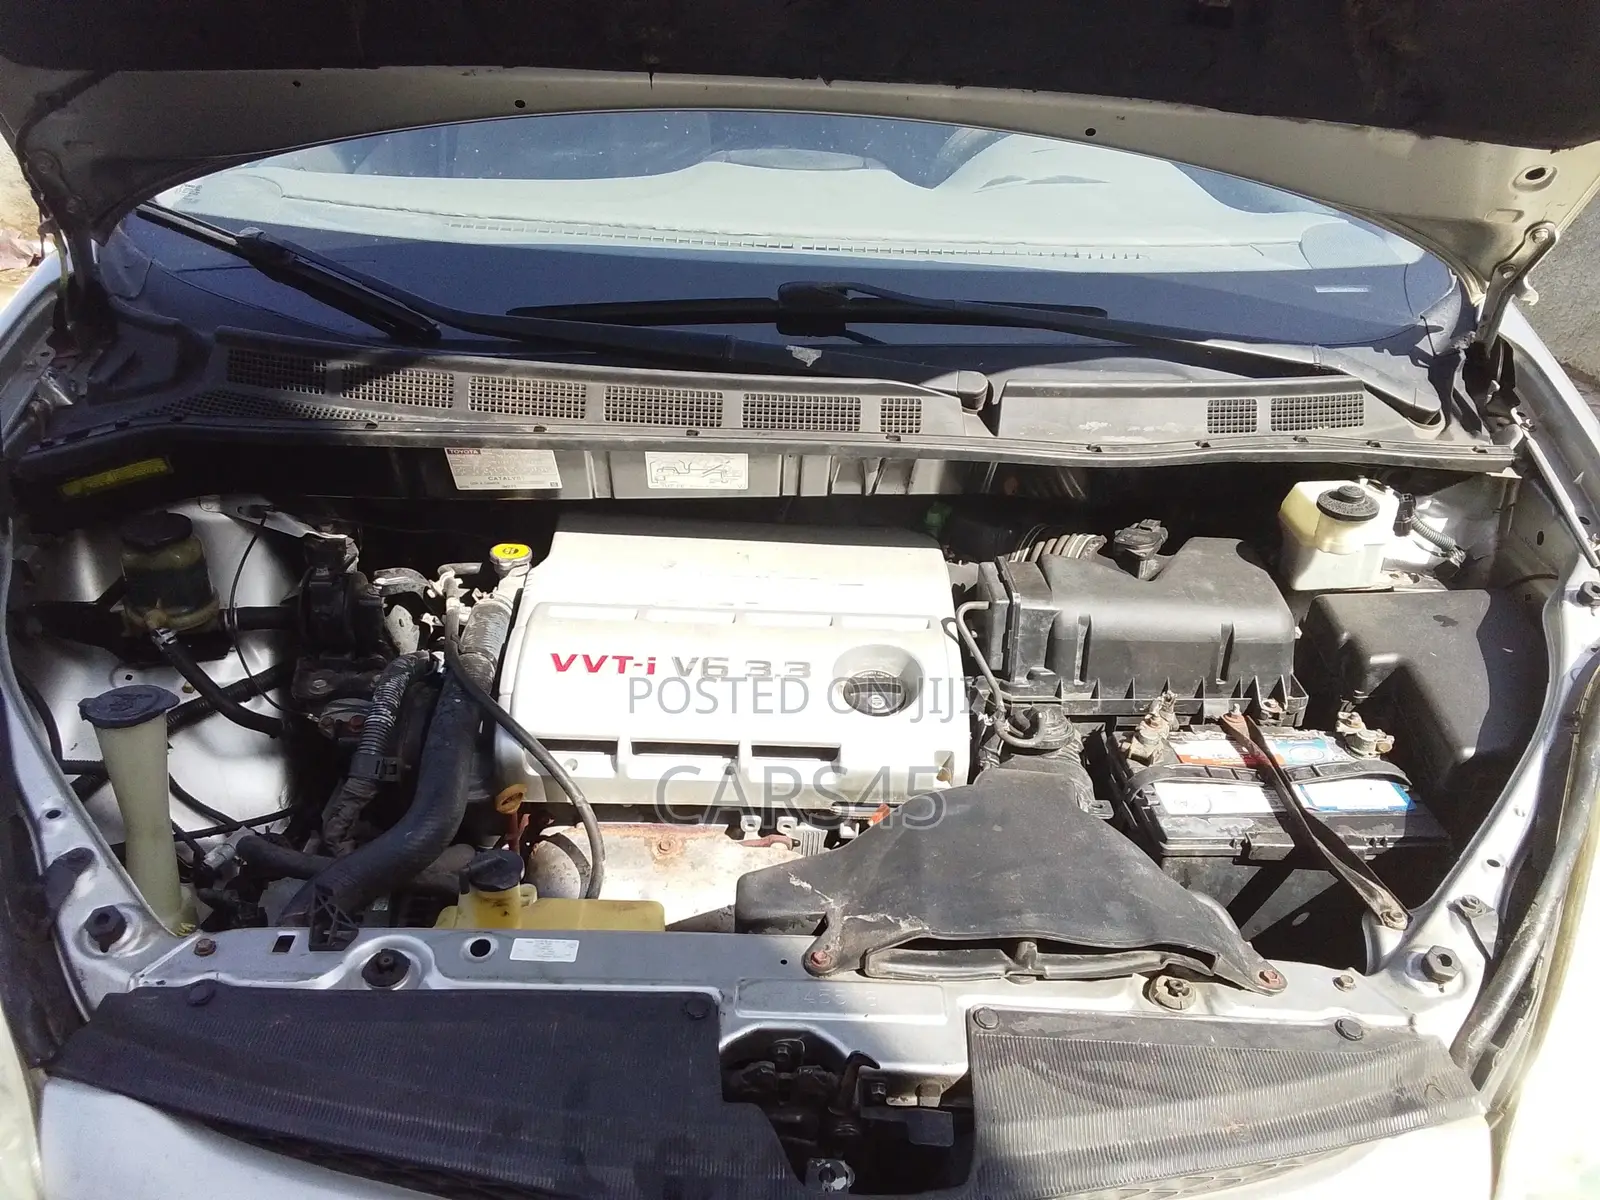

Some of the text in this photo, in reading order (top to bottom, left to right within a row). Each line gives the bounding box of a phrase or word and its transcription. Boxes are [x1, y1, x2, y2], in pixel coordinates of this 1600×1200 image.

[550, 653, 812, 679] VVT-i V6 3.3
